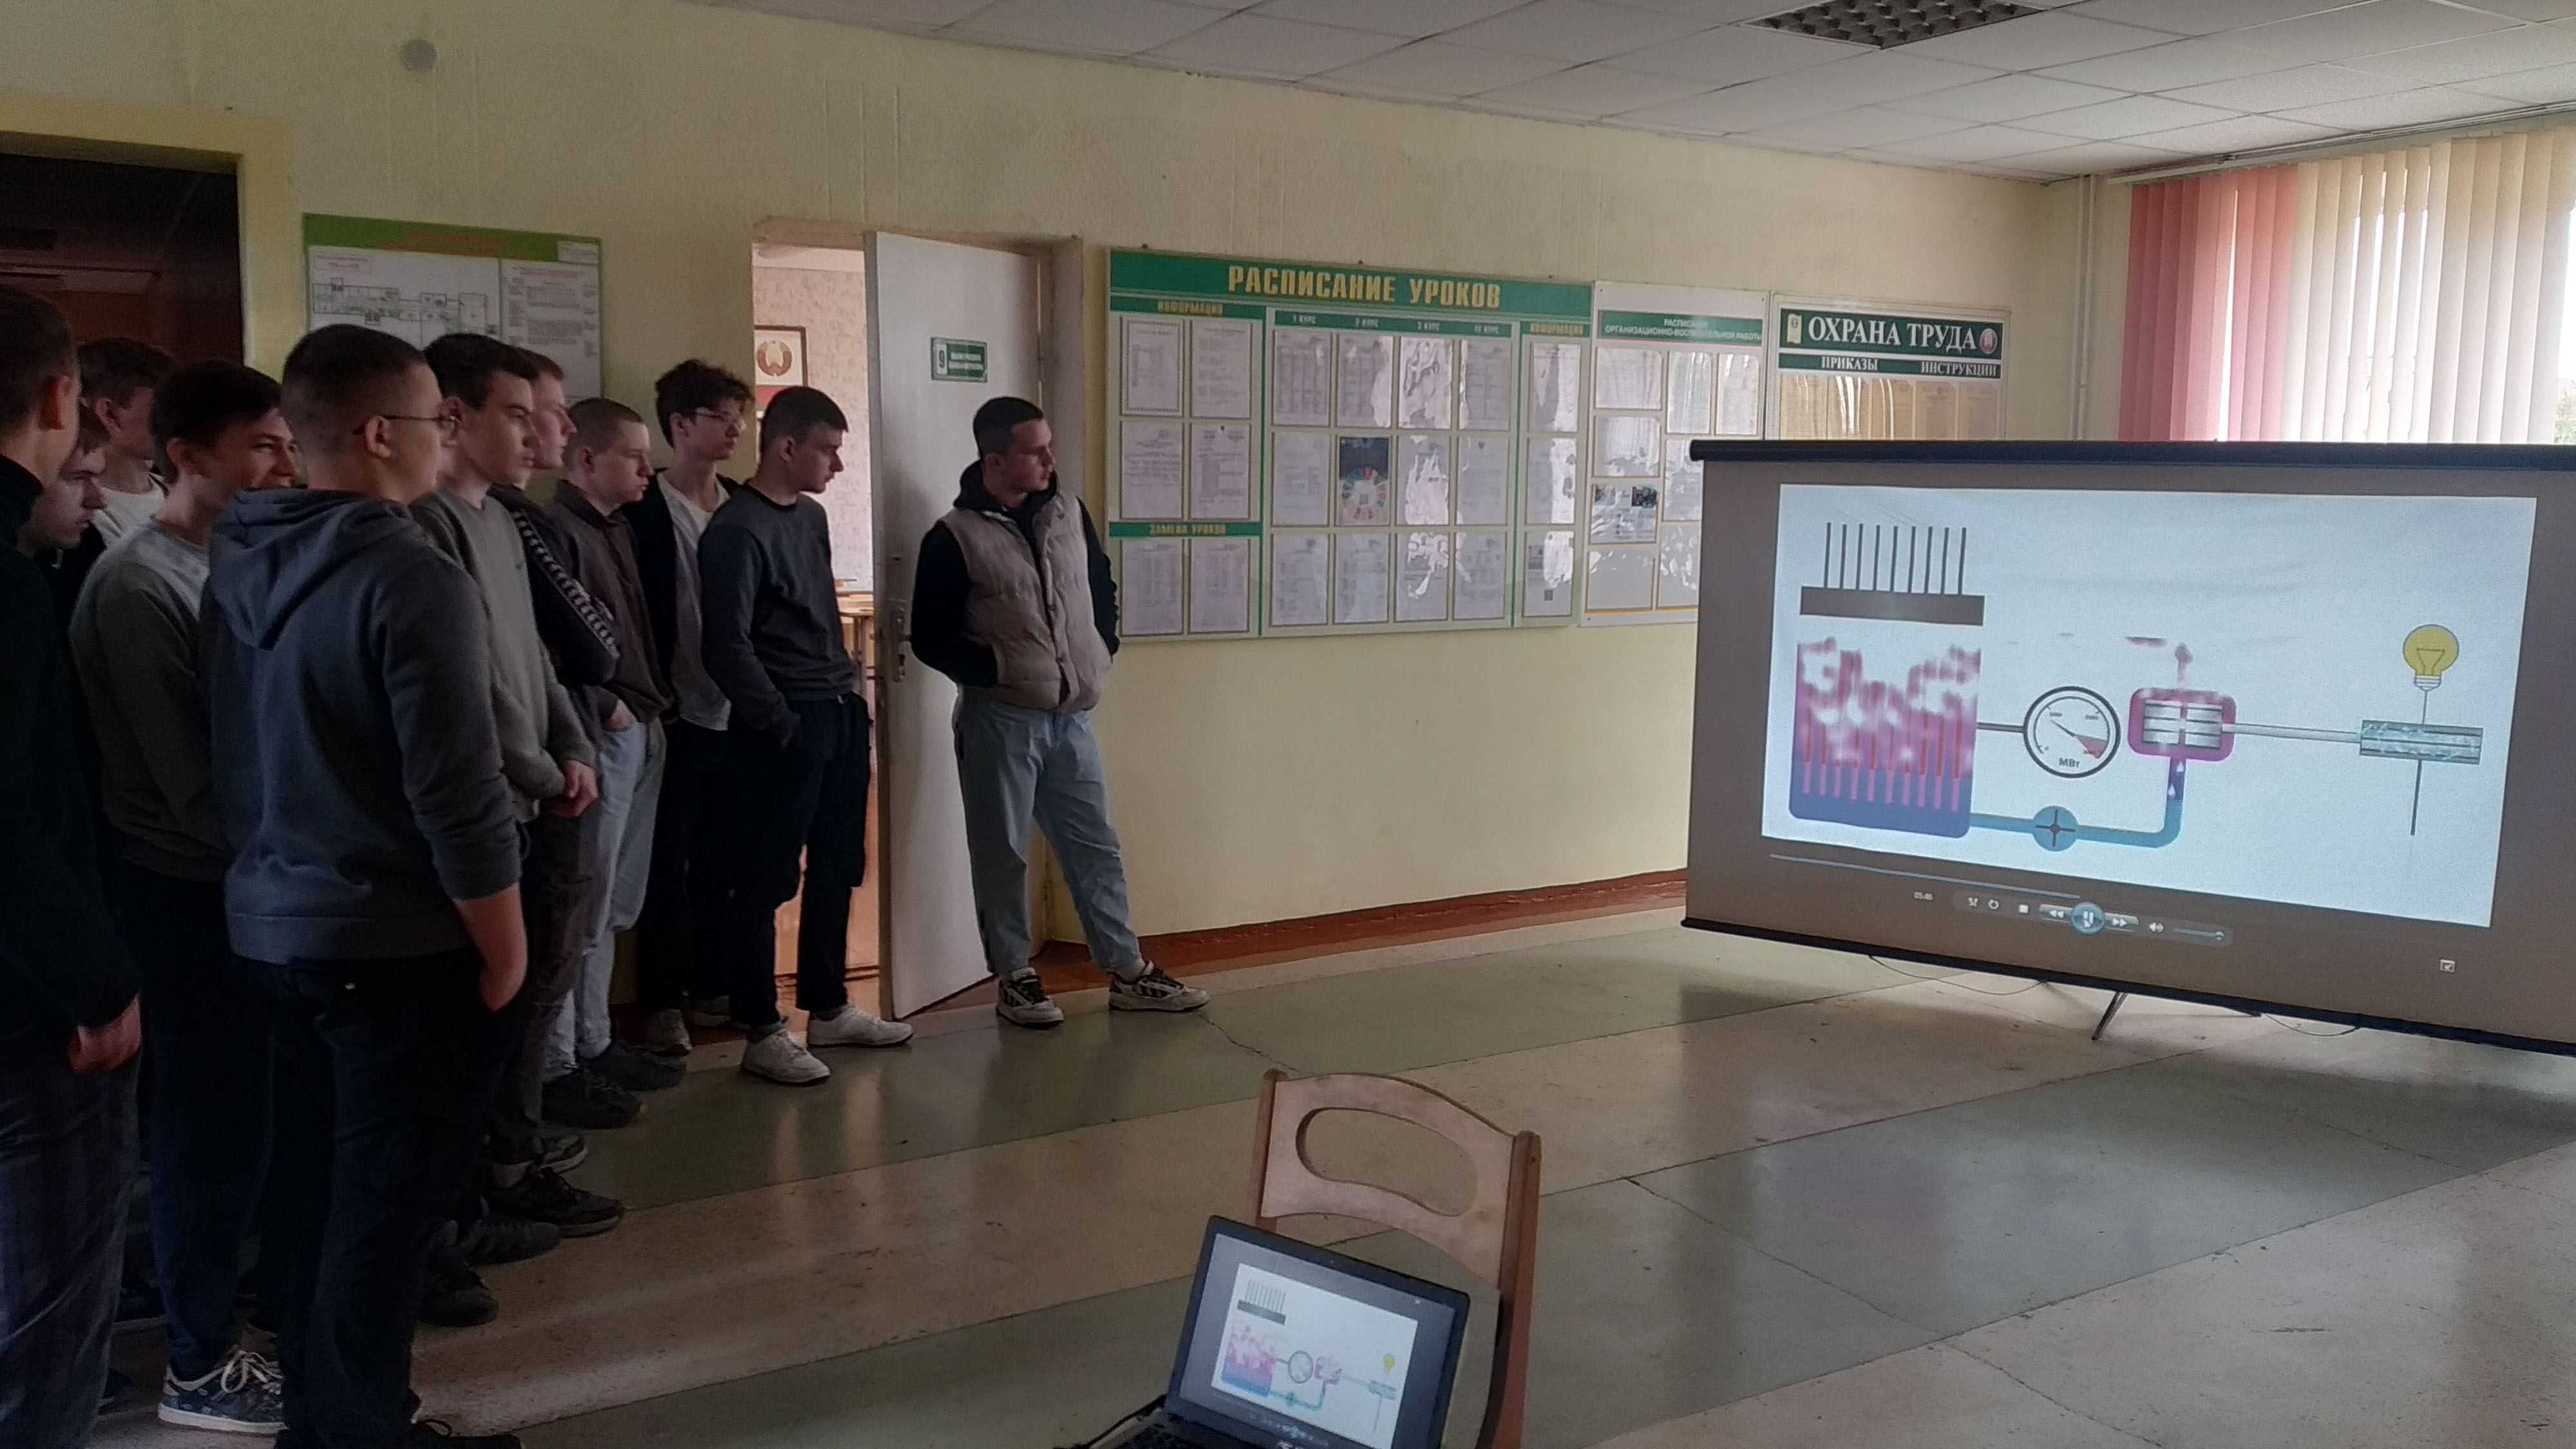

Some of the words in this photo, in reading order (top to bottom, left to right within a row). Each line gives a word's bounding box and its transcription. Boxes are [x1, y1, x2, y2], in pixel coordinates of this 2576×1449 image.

[1228, 265, 1396, 303] РАСПИСАНИЕ
[1409, 278, 1501, 309] УРОКОВ
[1664, 318, 1708, 328] РАСПИСА
[1808, 316, 1901, 346] ОХРАНА
[1907, 322, 1977, 354] ТРУДА
[1821, 356, 1878, 371] ПРИКАЗЫ
[1921, 361, 1997, 377] ИНСТРУКЦИИ
